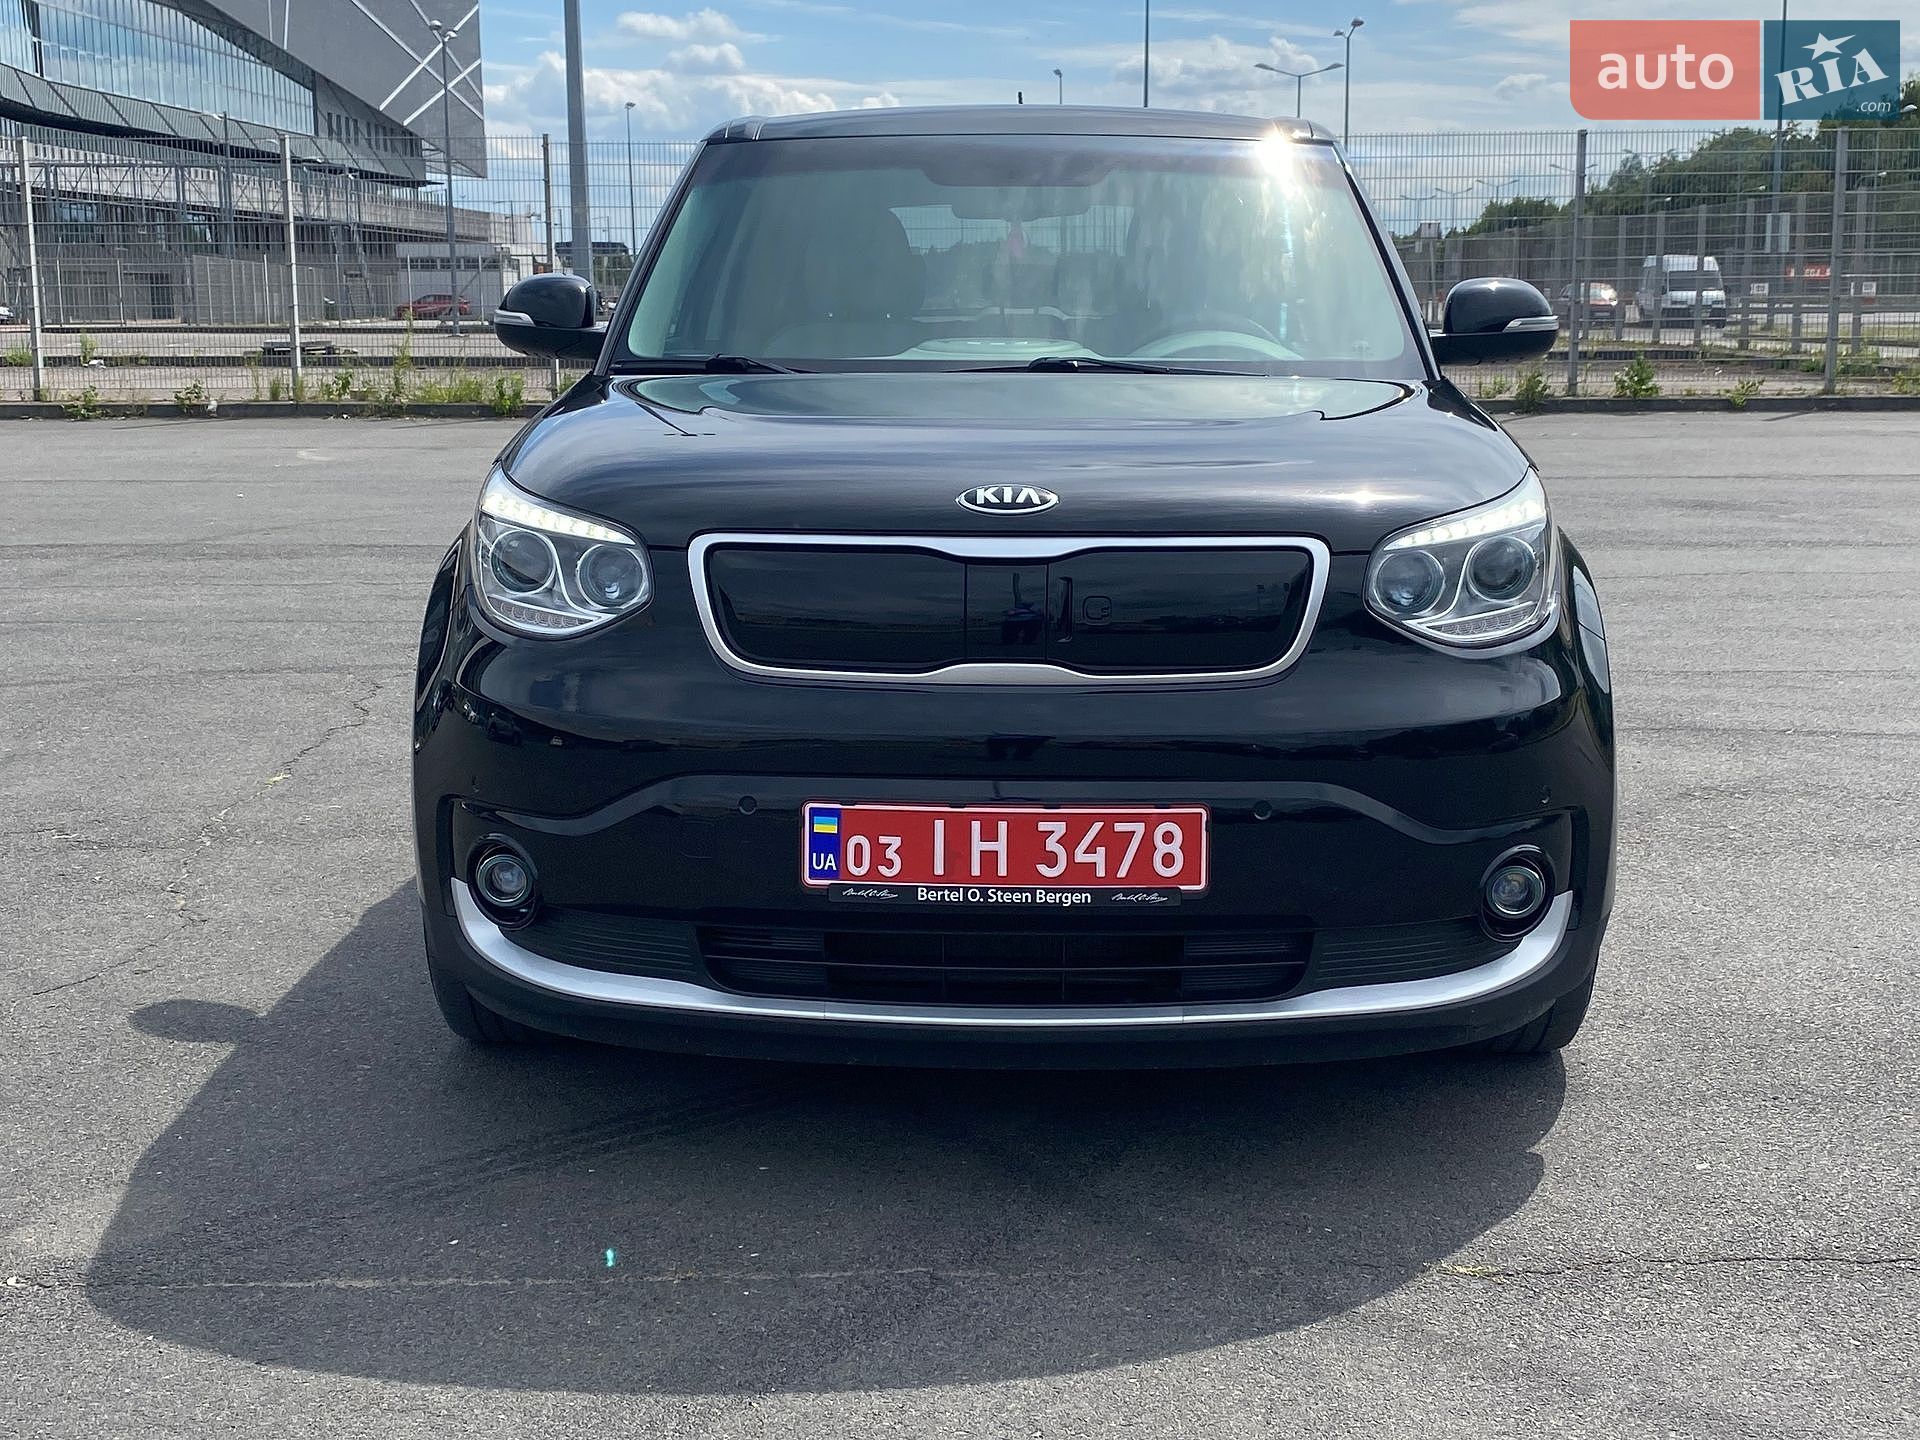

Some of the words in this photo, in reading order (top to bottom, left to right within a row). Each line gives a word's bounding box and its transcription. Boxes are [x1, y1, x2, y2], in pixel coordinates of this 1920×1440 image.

[976, 486, 1041, 505] KIA
[846, 835, 902, 878] 03
[1035, 821, 1184, 880] 3478
[812, 852, 837, 871] UA
[917, 887, 965, 902] Bertel
[968, 889, 985, 902] O.
[987, 889, 1033, 903] Steen
[1035, 890, 1092, 906] Bergen
